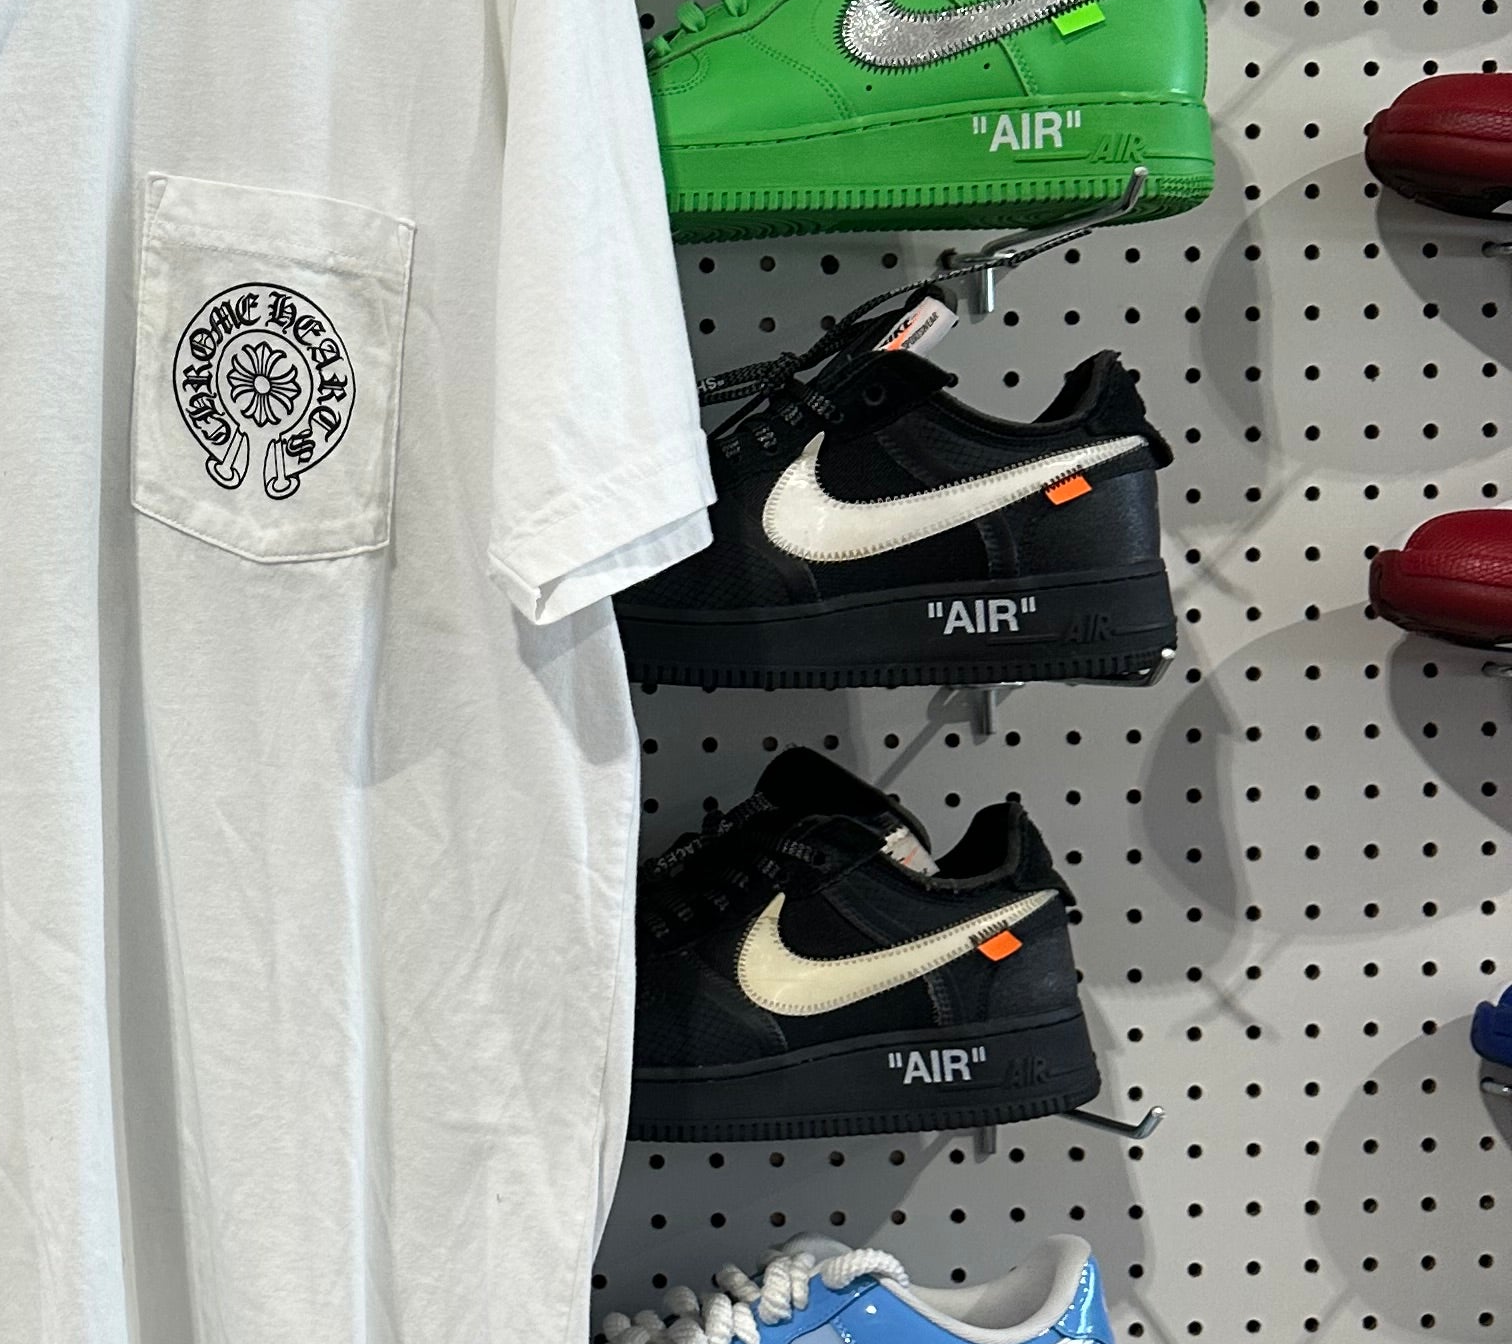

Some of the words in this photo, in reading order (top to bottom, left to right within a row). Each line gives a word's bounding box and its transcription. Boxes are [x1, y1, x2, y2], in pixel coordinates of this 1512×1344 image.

[972, 109, 1081, 153] "AIR"
[1087, 132, 1145, 164] AIR
[181, 292, 261, 446] CHROME
[928, 596, 1037, 636] "AIR"
[888, 1046, 987, 1085] "AIR"
